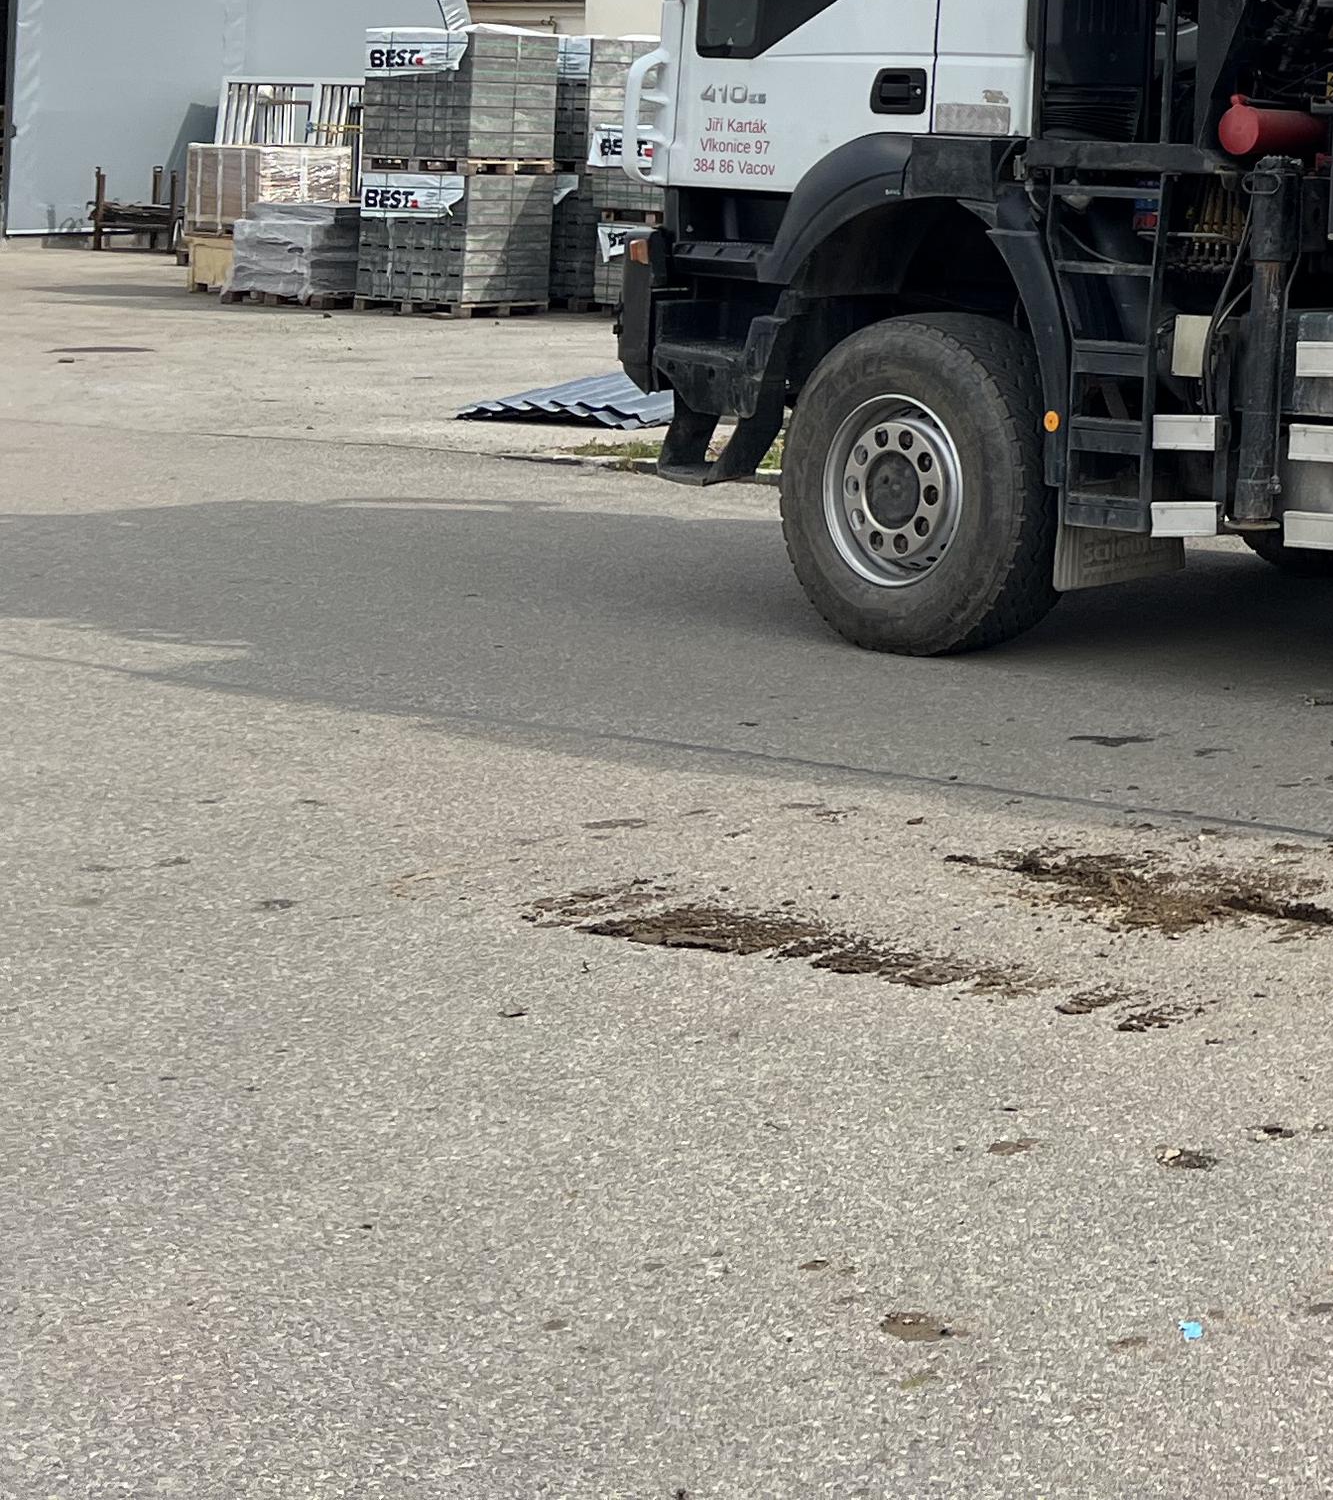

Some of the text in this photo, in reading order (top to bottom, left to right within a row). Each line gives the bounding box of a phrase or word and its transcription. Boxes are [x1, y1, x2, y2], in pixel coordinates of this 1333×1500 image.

[370, 49, 421, 67] BEST
[701, 84, 748, 104] 410
[705, 117, 768, 133] Jiří Karták
[700, 137, 770, 155] Vlkonice 97
[693, 158, 776, 176] 384 86 Vacov
[365, 189, 415, 208] BEST
